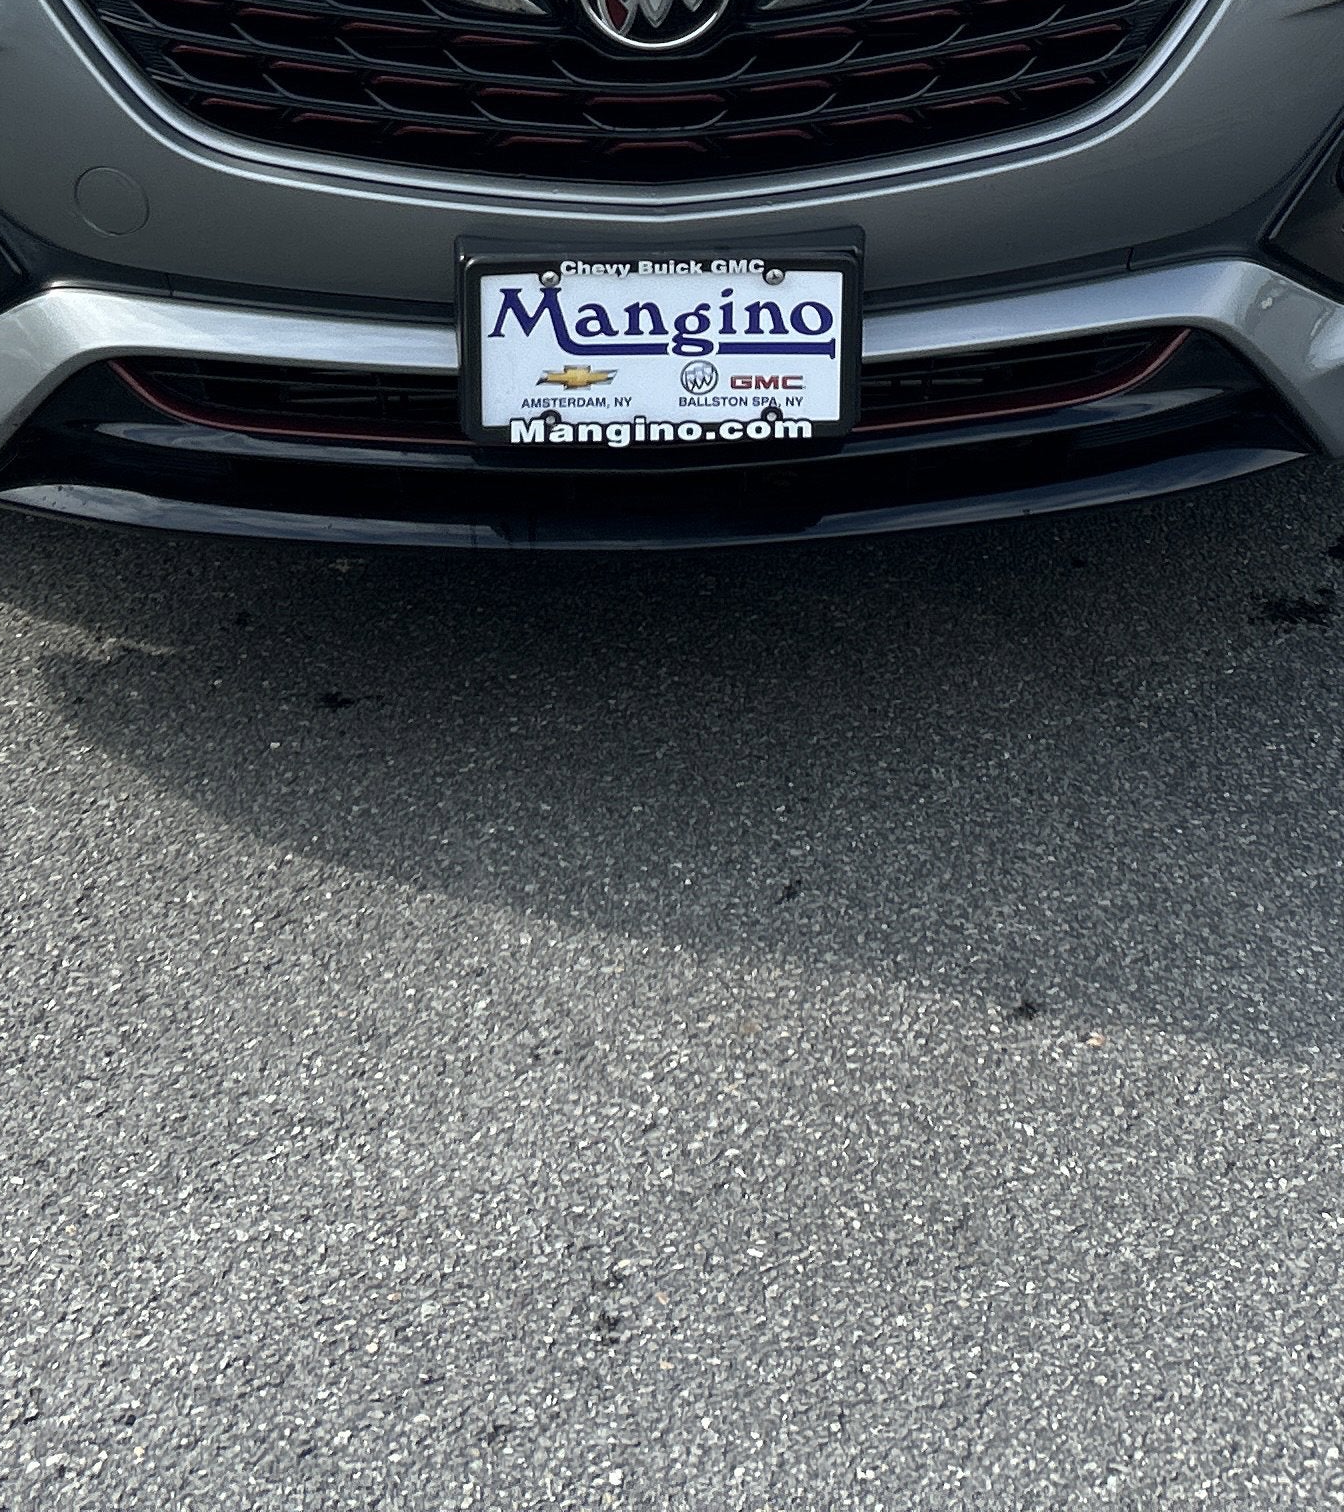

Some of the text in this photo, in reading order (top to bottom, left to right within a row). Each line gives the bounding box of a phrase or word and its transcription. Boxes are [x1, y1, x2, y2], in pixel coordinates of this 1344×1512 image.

[560, 259, 765, 278] Chevy Buick GMC
[487, 287, 836, 359] Mangino
[730, 375, 804, 390] GMC
[521, 396, 633, 409] AMSTERDAM, NY
[678, 396, 804, 408] BALLSTON SPA, NY
[510, 417, 813, 448] Mangino.com
